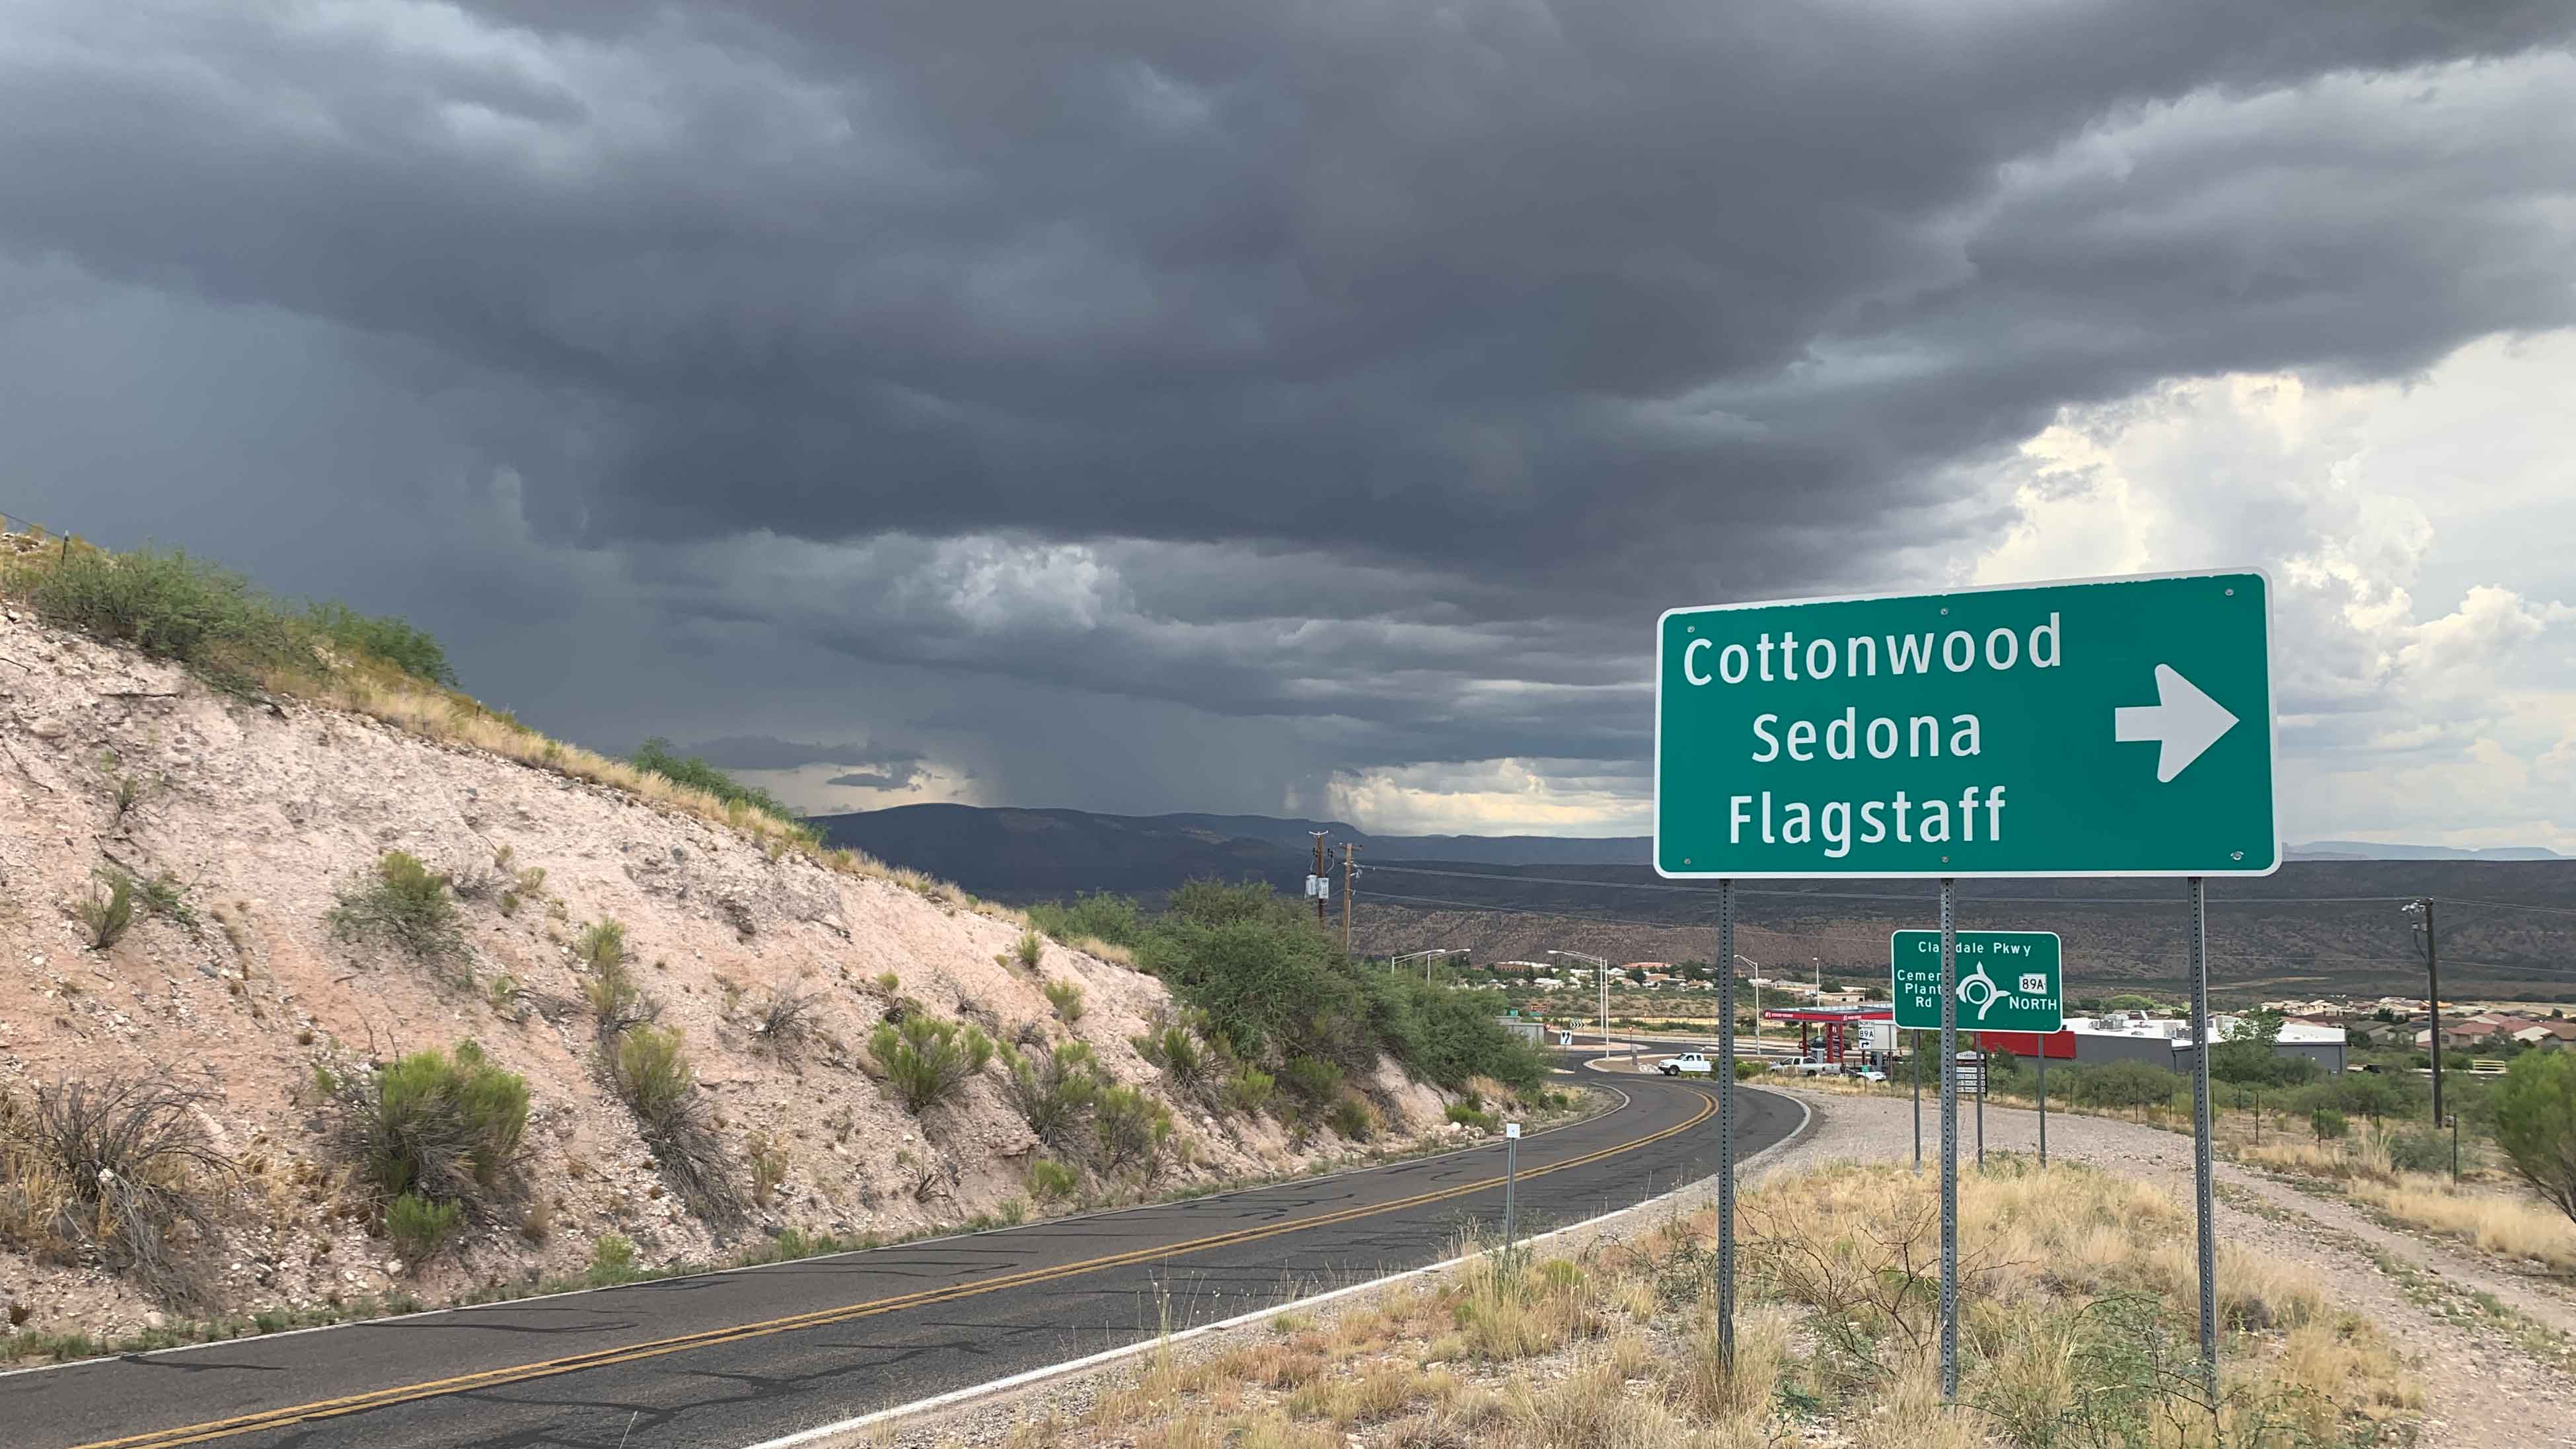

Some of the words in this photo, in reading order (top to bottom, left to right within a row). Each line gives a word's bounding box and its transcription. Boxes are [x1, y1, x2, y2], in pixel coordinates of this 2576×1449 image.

[1683, 612, 2062, 687] Cottonwood
[1751, 706, 1982, 763] Sedona
[1729, 785, 2006, 858] Flagstaff
[1918, 941, 1985, 953] Cladale
[1993, 942, 2032, 957] Pkwy
[1905, 983, 1942, 995] Plant
[2022, 978, 2044, 990] 89A
[1915, 996, 1932, 1008] Rd
[2009, 996, 2057, 1010] NORTH
